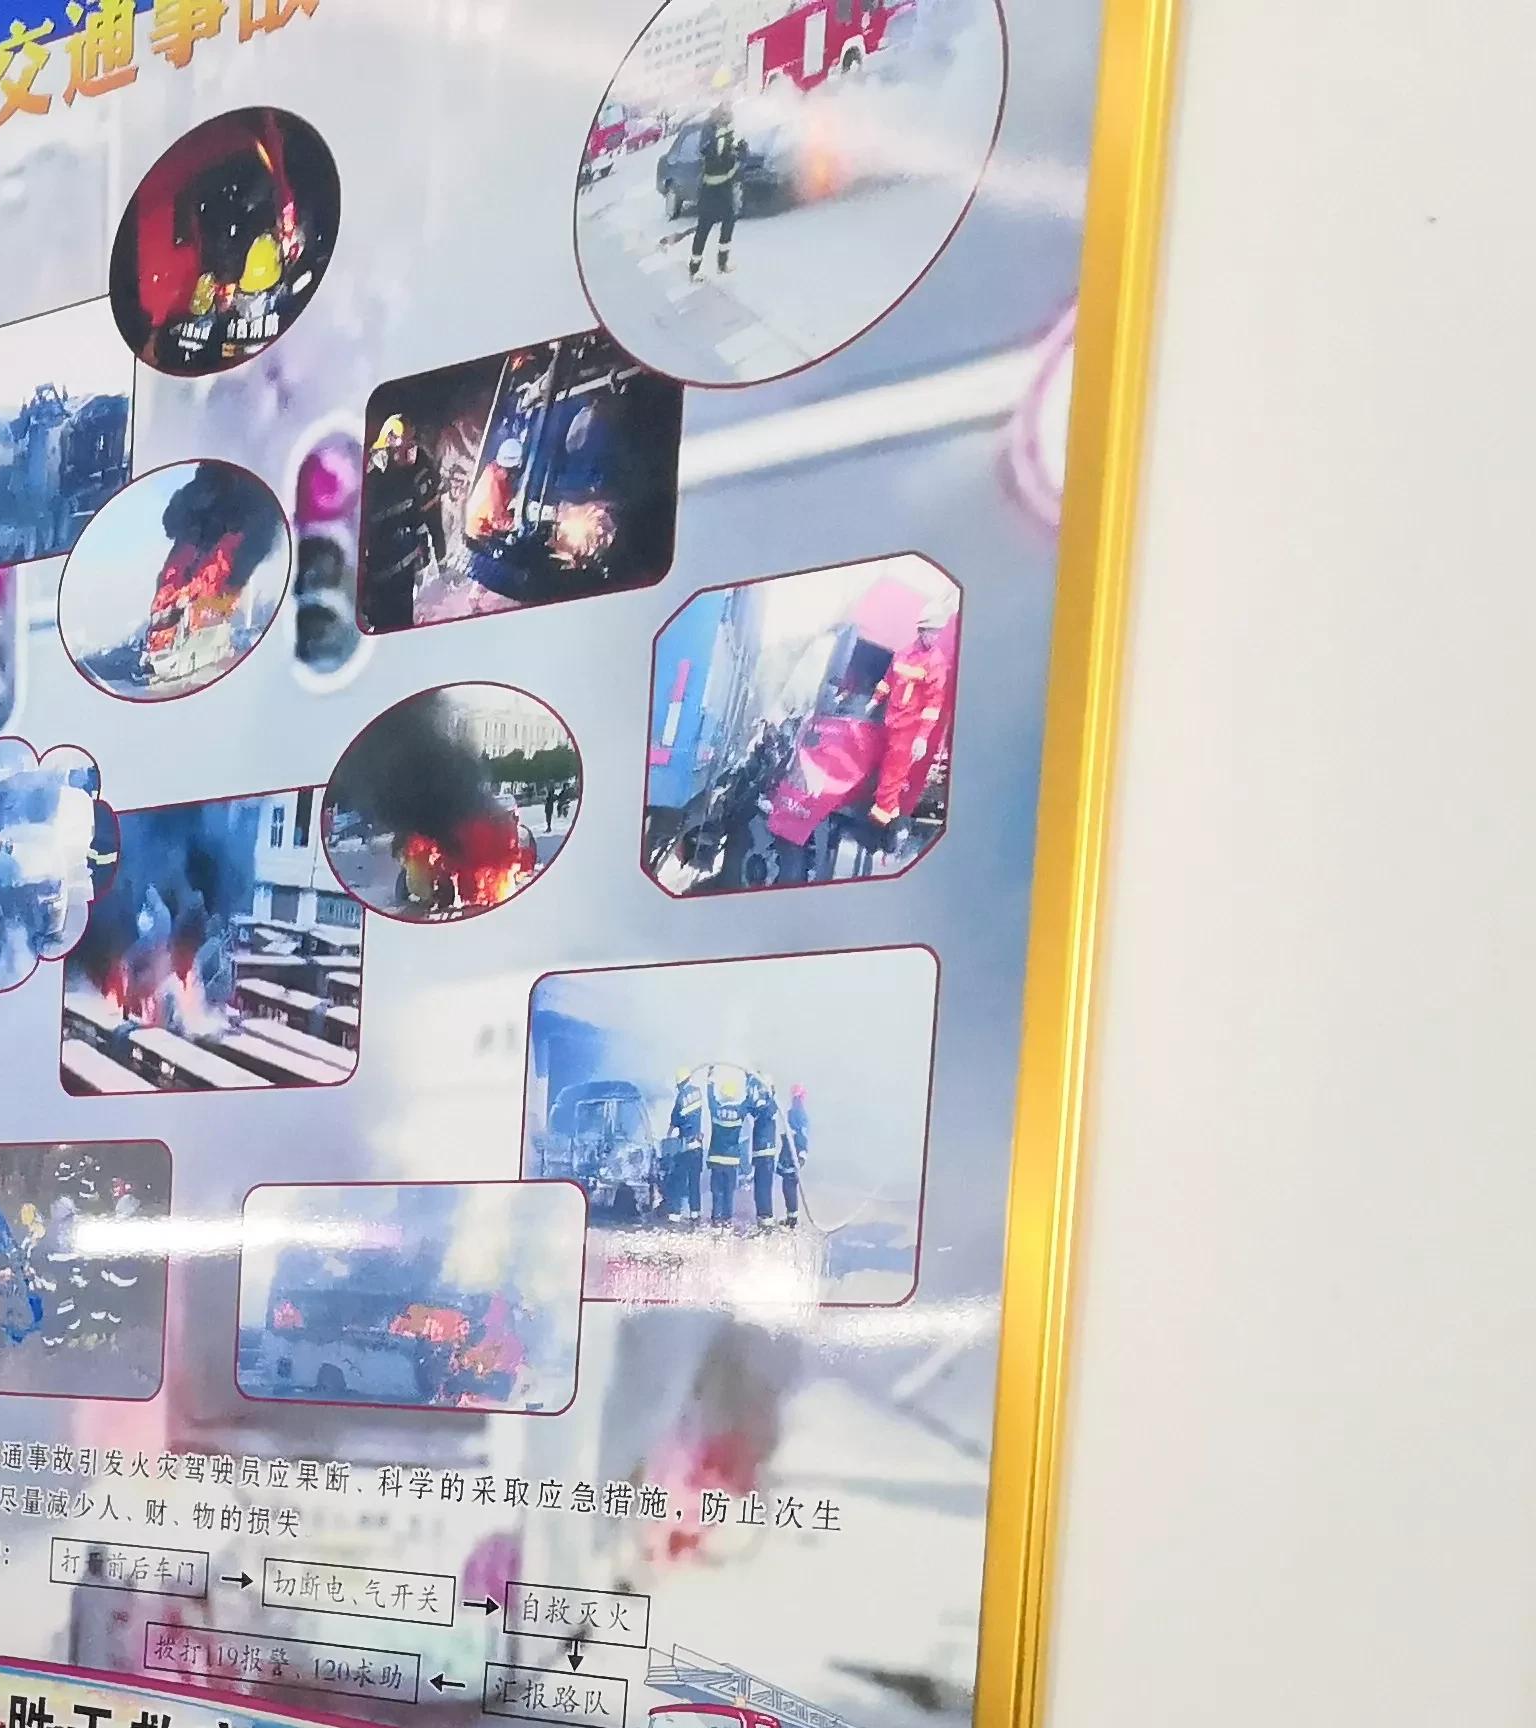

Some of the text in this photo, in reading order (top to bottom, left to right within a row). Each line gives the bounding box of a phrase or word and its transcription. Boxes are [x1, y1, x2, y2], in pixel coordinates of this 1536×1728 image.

[522, 1592, 631, 1632] 自救灭火
[493, 1677, 610, 1717] 汇报路队
